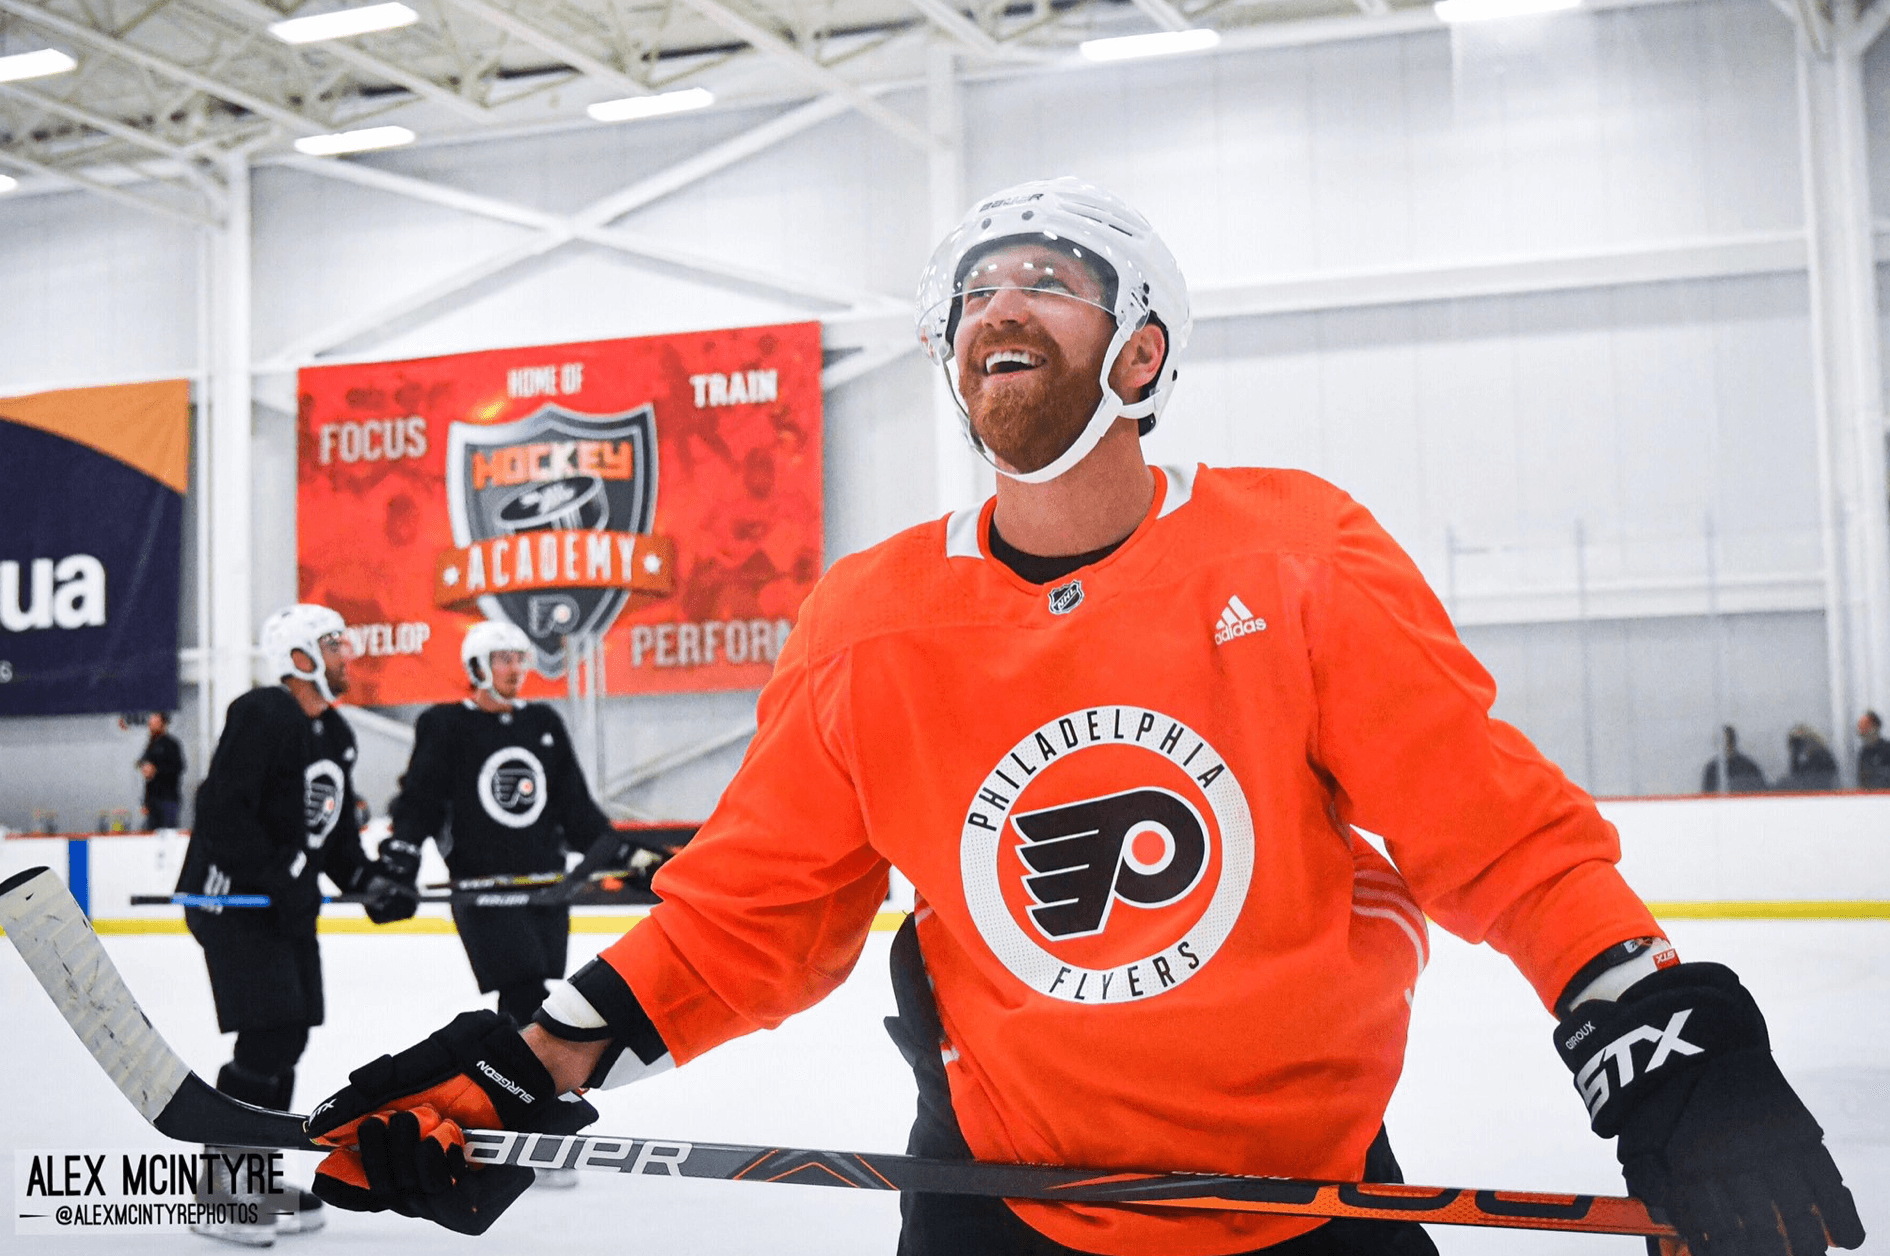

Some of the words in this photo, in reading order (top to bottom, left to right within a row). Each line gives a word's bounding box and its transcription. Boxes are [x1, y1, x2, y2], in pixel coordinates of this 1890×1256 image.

[508, 365, 557, 399] HOME
[561, 362, 583, 396] OF
[690, 369, 778, 408] TRAIN
[319, 415, 427, 465] FOCUS
[472, 440, 633, 490] HOCKEY
[467, 533, 635, 592] ACADEMY
[344, 622, 430, 656] VELOP
[1214, 617, 1267, 645] adidas
[968, 709, 1225, 831] PHILADELPHIA
[1050, 941, 1200, 1000] FLYERS
[1565, 1020, 1596, 1050] GIROUX
[476, 1060, 535, 1104] SURGEON
[1576, 1008, 1705, 1120] STX
[464, 1130, 693, 1177] AUER
